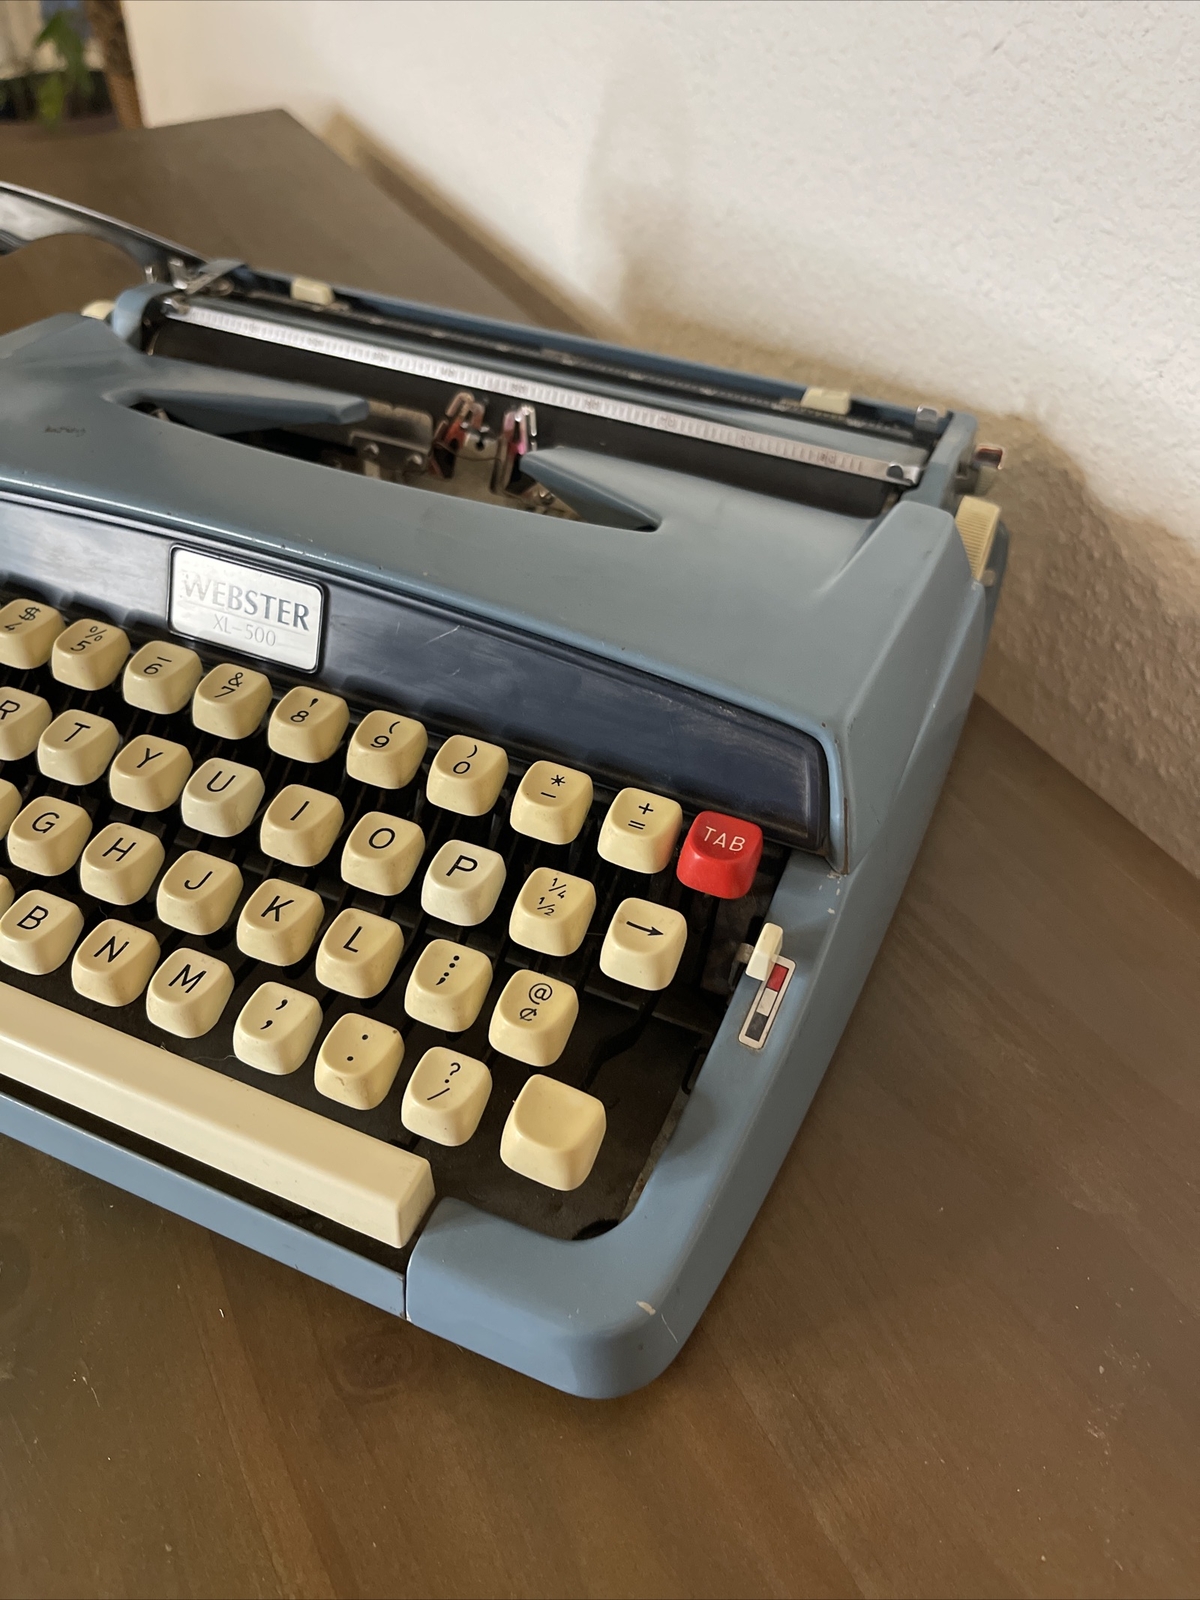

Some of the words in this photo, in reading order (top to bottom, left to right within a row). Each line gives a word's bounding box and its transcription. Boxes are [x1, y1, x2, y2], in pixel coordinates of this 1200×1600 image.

[182, 572, 310, 632] WEBSTER
[18, 606, 41, 621] $
[4, 622, 22, 631] 4
[83, 626, 107, 643] %
[70, 640, 91, 652] 5
[143, 663, 163, 675] 6
[227, 672, 244, 688] &
[214, 685, 236, 698] 7
[0, 699, 21, 720] R
[290, 710, 310, 723] 8
[63, 722, 91, 742] T
[388, 721, 401, 735] (
[370, 735, 390, 749] 9
[466, 744, 478, 759] )
[136, 747, 163, 769] Y
[206, 770, 236, 793] U
[638, 802, 654, 815] +
[31, 812, 60, 834] G
[627, 820, 646, 830] =
[368, 827, 396, 850] O
[704, 826, 746, 852] TAB
[101, 837, 137, 862] H
[445, 854, 478, 877] P
[184, 871, 213, 890] J
[16, 905, 49, 930] B
[260, 895, 295, 922] K
[93, 935, 130, 963] N
[342, 926, 362, 953] L
[168, 963, 207, 994] M
[528, 982, 553, 1006] @
[519, 1007, 538, 1022] ¢
[446, 1062, 461, 1084] ?
